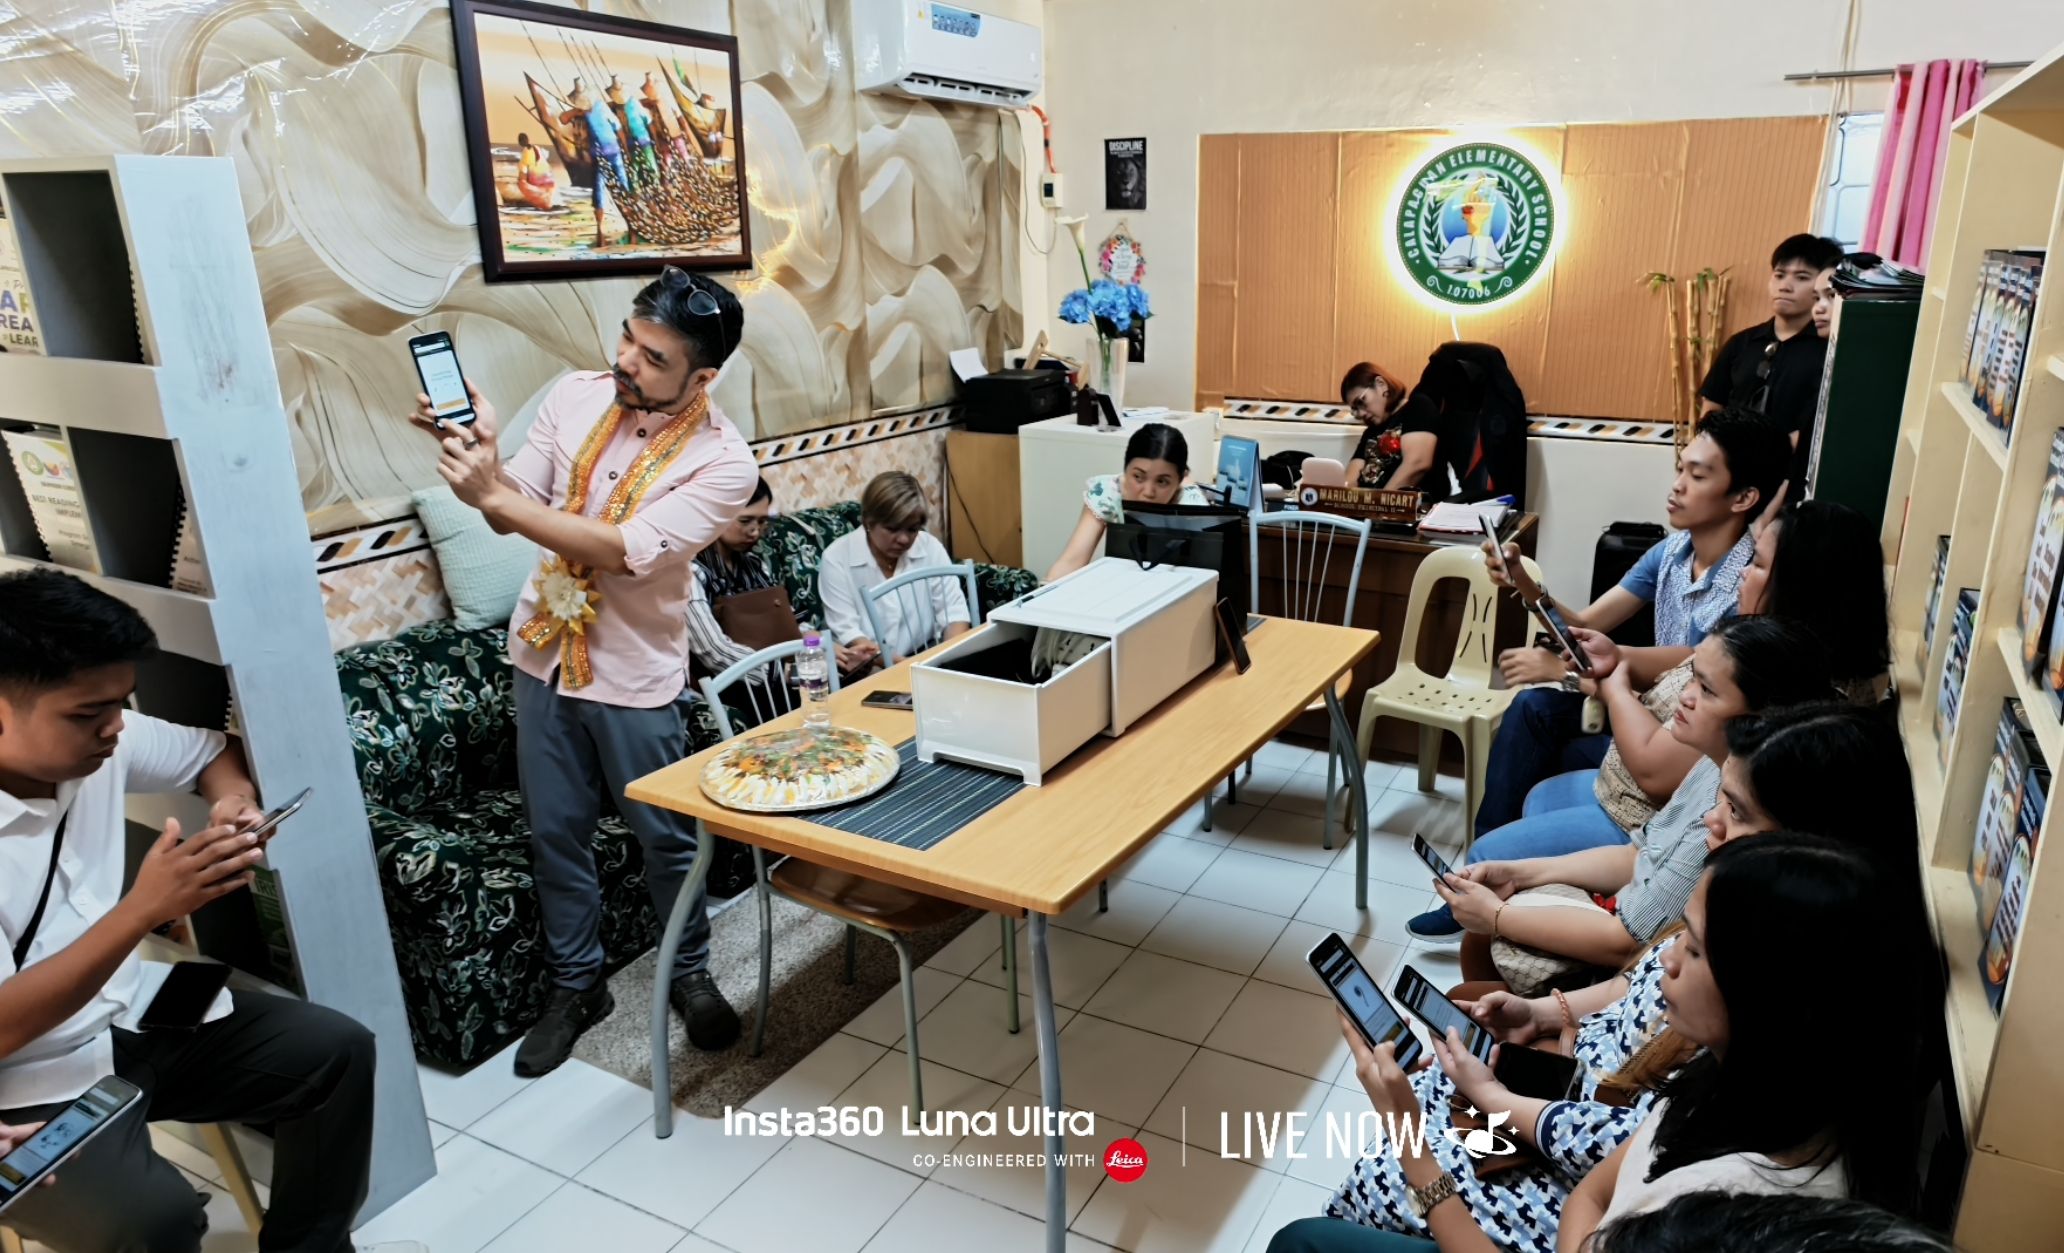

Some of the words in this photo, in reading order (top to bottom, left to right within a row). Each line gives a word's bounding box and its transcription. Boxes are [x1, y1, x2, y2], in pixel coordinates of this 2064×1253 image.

[1448, 149, 1540, 191] ELEMENTARY
[1528, 193, 1548, 259] SCHOOL
[1319, 488, 1359, 503] MARILOU
[1363, 491, 1376, 505] M.
[1381, 493, 1415, 508] NICART
